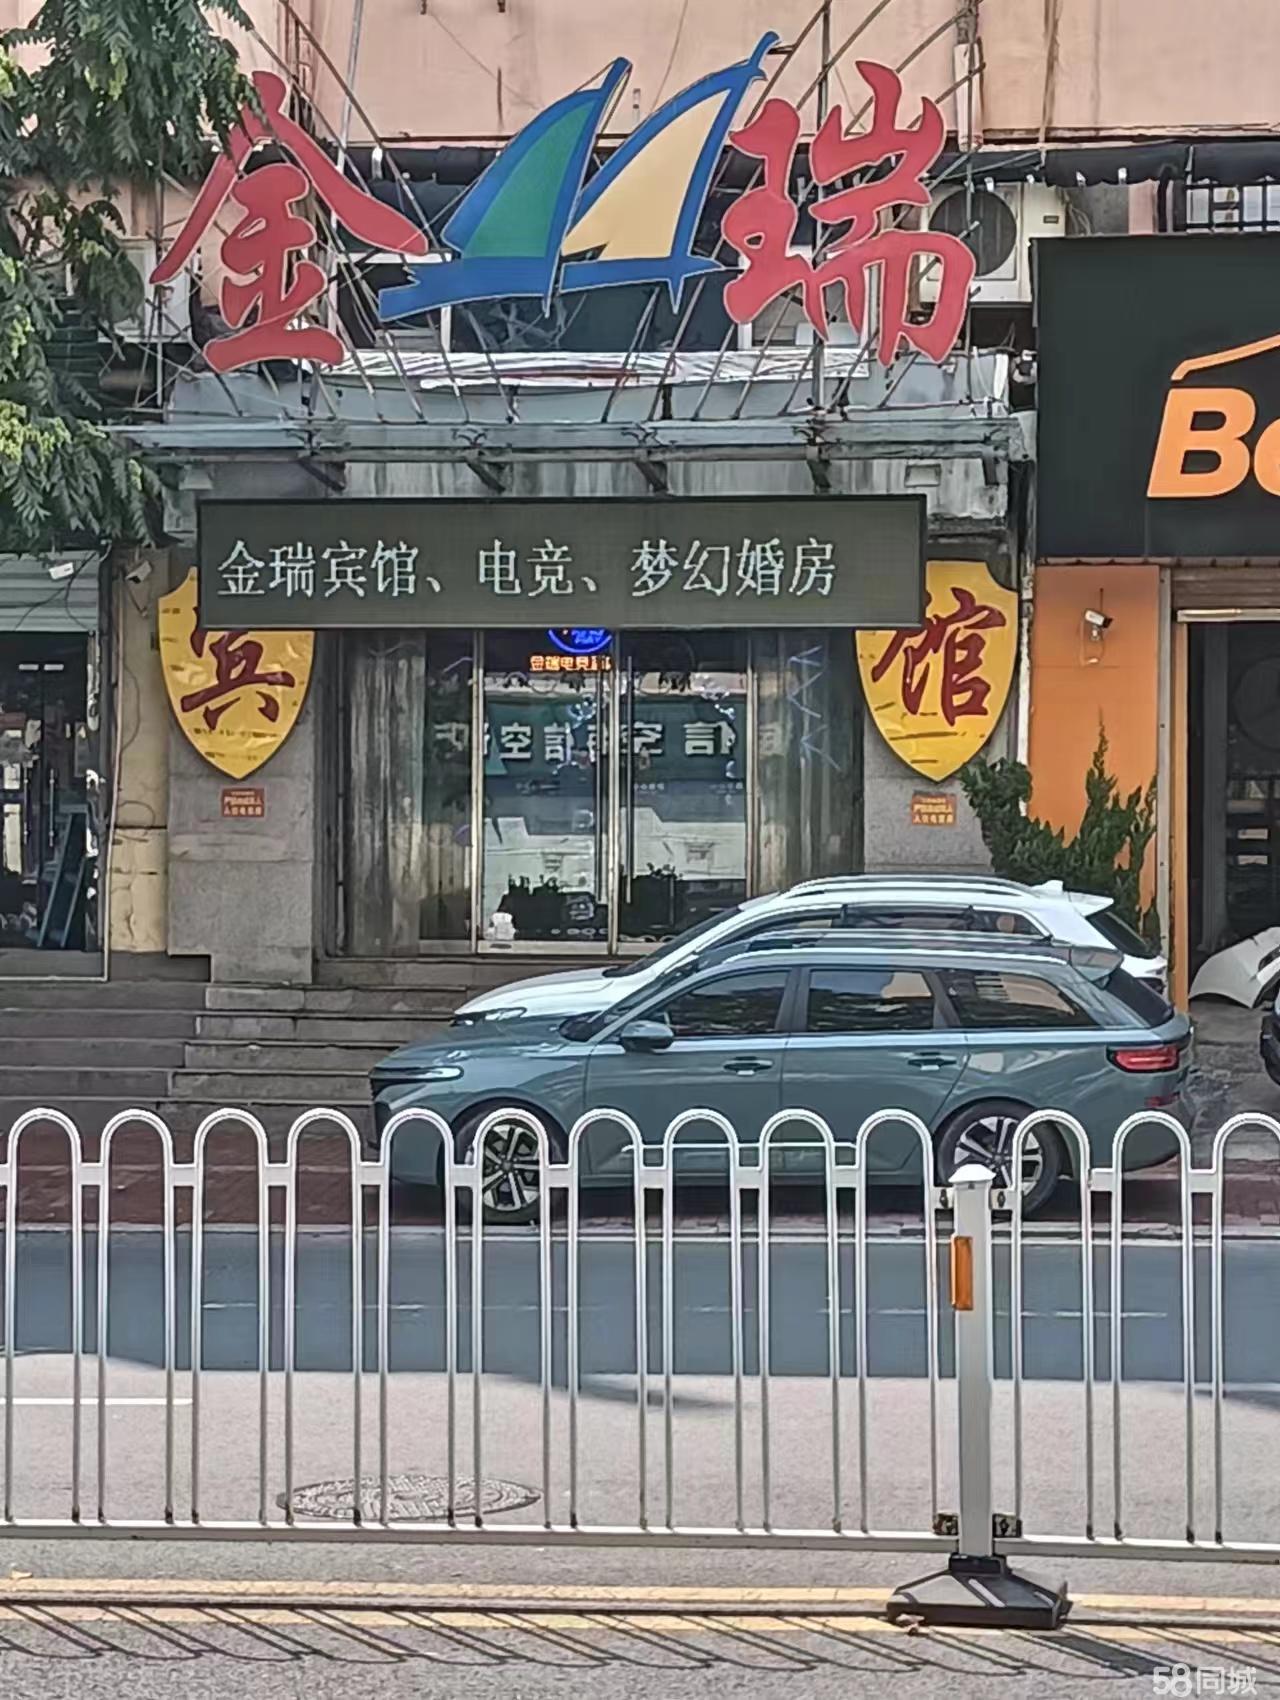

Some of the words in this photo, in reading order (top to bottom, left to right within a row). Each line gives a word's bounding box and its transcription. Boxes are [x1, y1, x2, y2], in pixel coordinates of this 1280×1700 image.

[150, 70, 429, 373] 金
[722, 60, 977, 368] 瑞
[217, 538, 836, 598] 金瑞宾馆、电竞、梦幻婚房
[872, 587, 1007, 727] 馆
